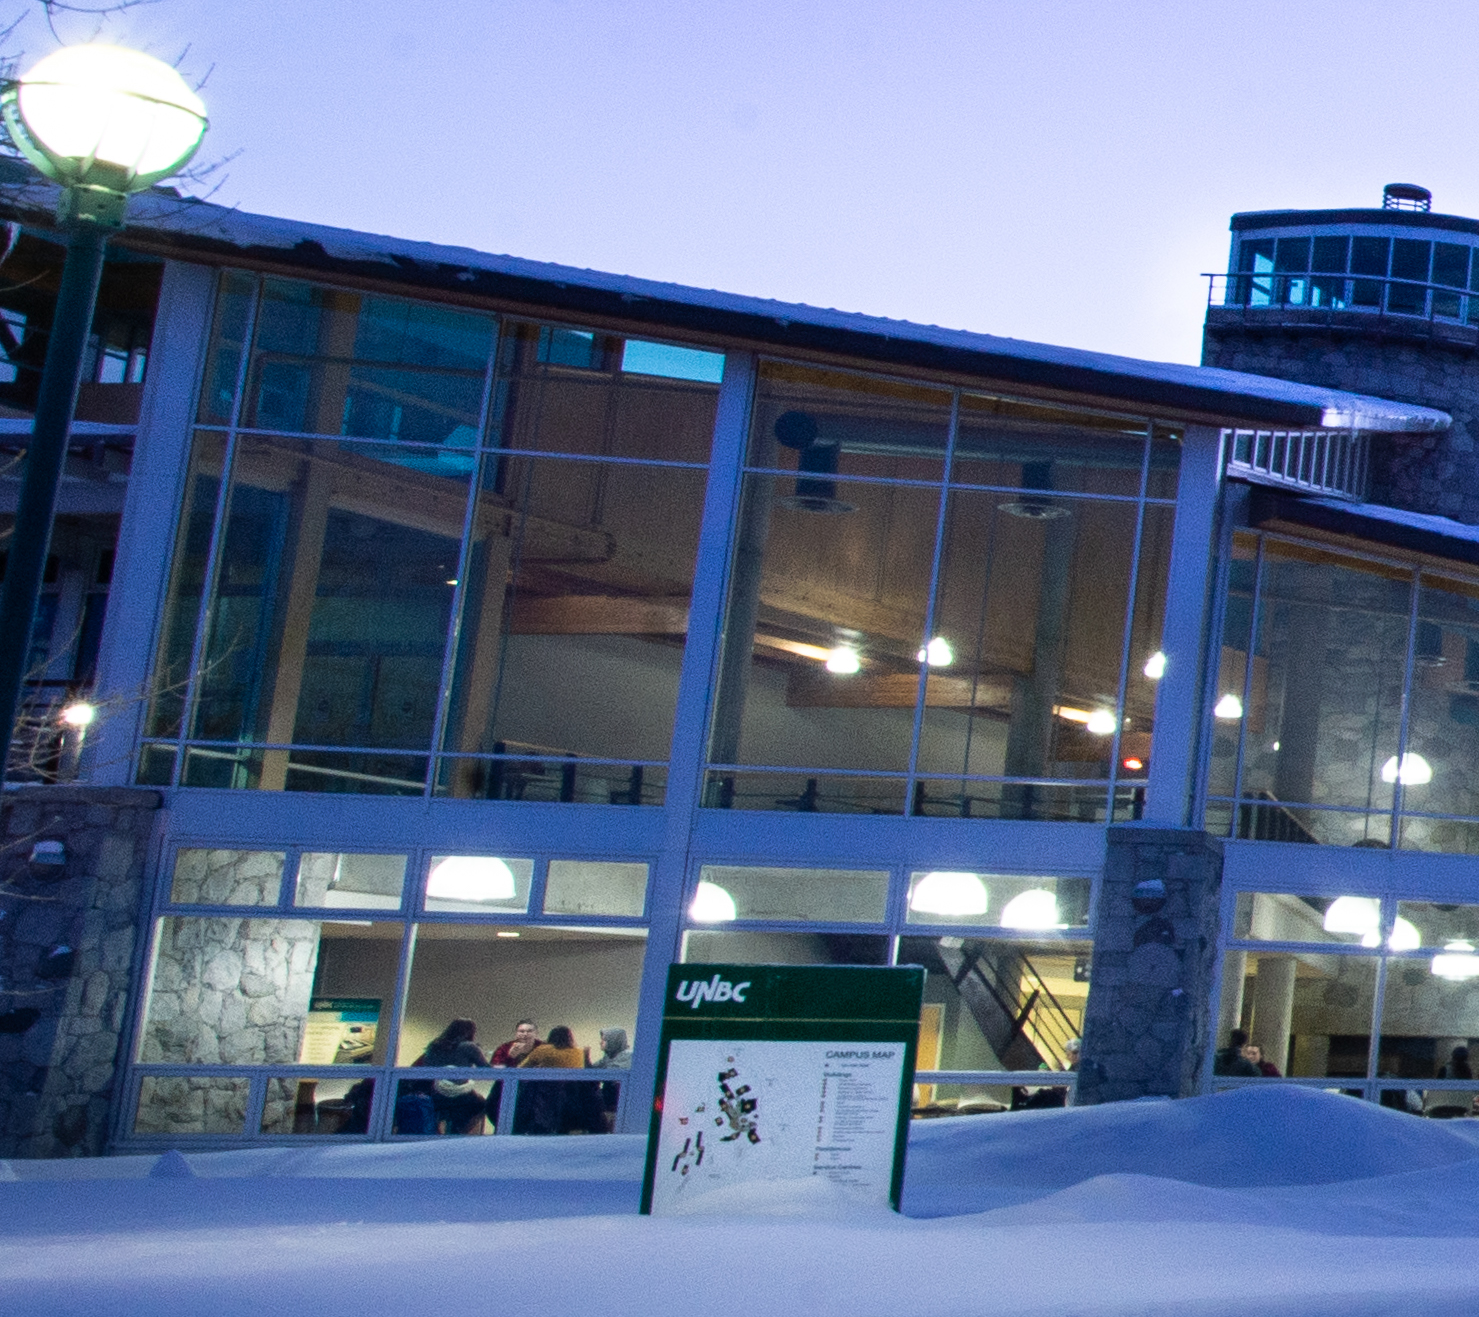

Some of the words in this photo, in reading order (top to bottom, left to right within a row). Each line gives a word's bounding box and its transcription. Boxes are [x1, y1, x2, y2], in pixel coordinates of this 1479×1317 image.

[676, 974, 751, 1009] UNBC
[826, 1050, 870, 1059] CAMPUS
[872, 1051, 895, 1059] MAP
